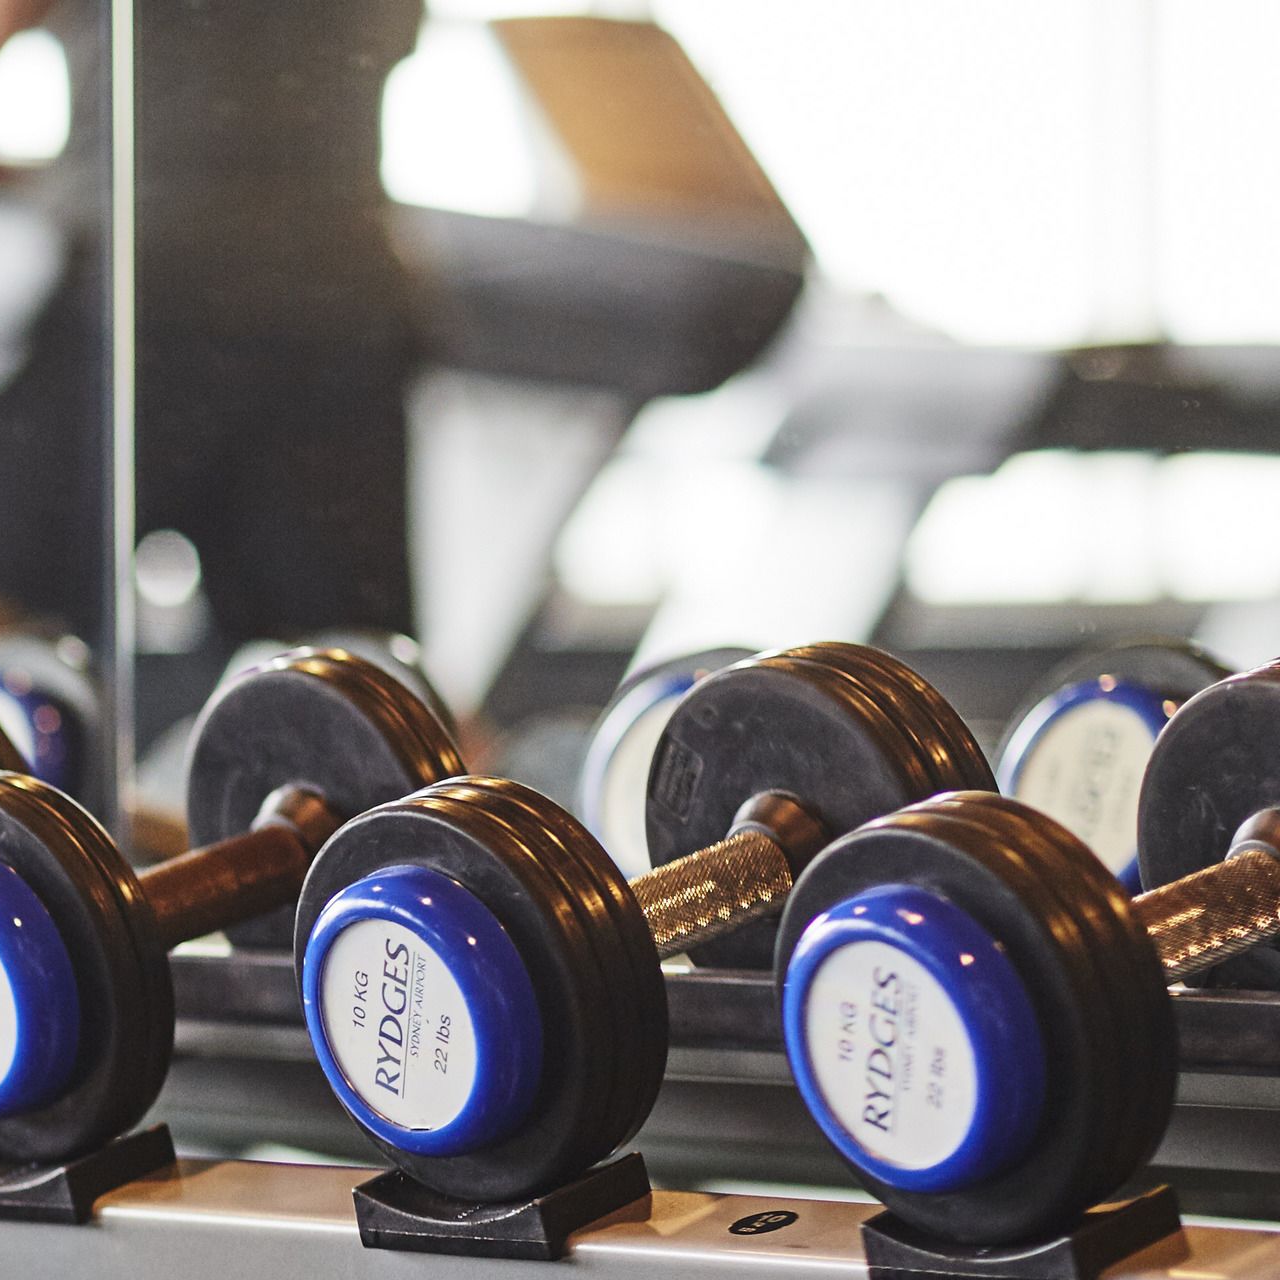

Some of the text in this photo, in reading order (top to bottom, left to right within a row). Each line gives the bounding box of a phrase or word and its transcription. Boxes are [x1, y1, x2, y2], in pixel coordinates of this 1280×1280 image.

[351, 970, 369, 1029] 10 KG
[374, 938, 411, 1096] RYDGES
[410, 955, 428, 1058] SYDNEY AIRPORT
[837, 1001, 858, 1062] 10 KG
[434, 1014, 452, 1075] 22 lbs
[863, 965, 899, 1132] RYDGES
